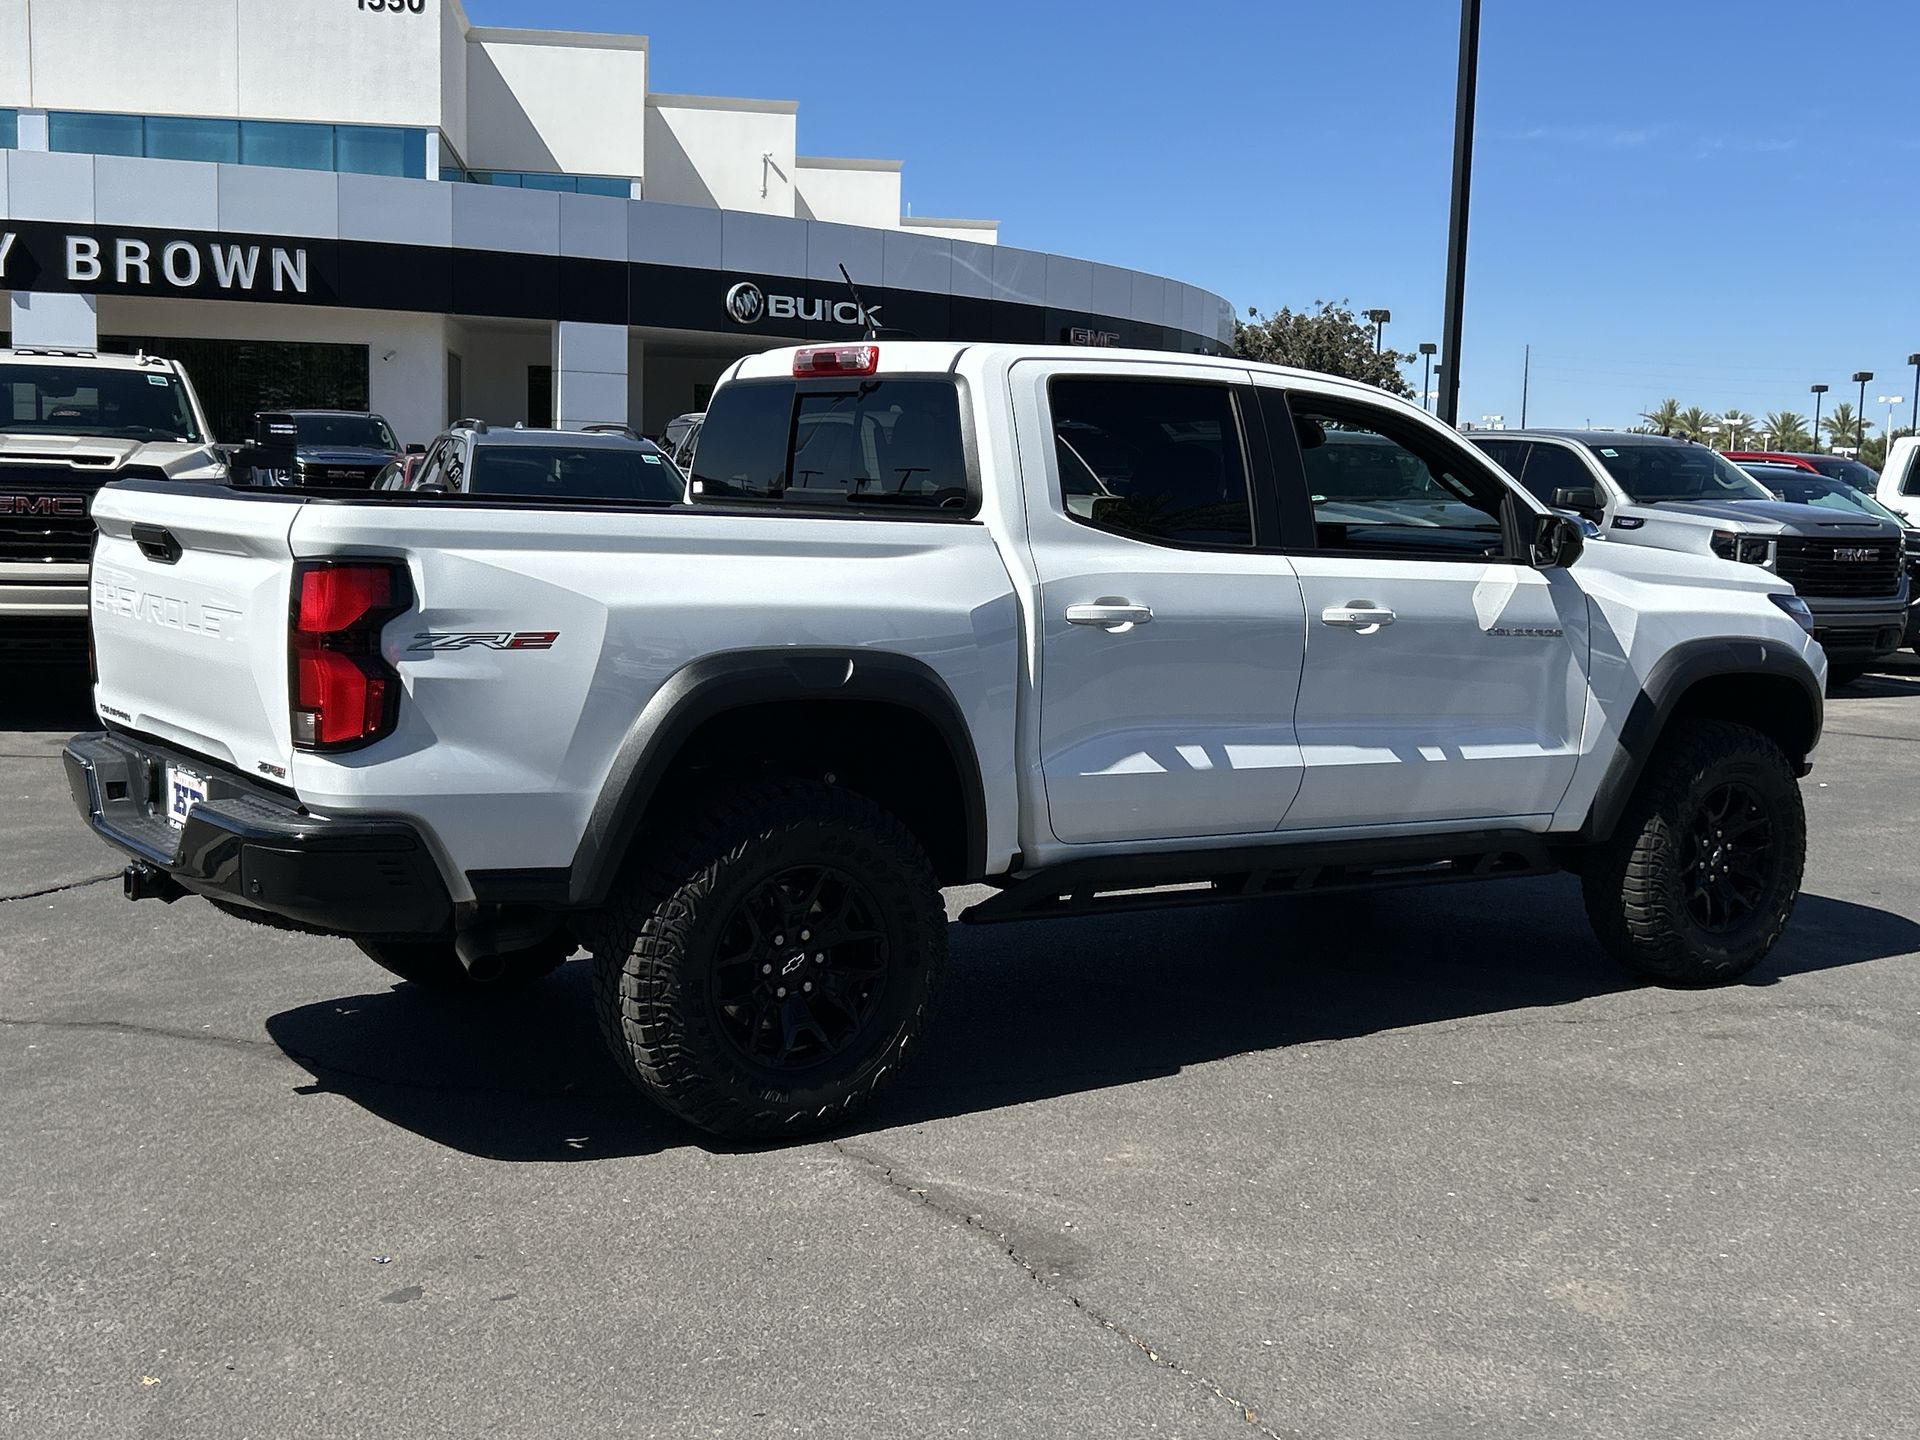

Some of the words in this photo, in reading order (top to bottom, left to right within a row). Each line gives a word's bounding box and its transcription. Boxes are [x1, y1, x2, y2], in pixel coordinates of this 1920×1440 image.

[66, 235, 307, 293] BROWN
[768, 294, 883, 327] BUICK
[1071, 327, 1120, 347] GMC
[1833, 548, 1880, 562] GMC
[93, 579, 244, 642] CHEVROLET
[406, 631, 560, 651] ZR2
